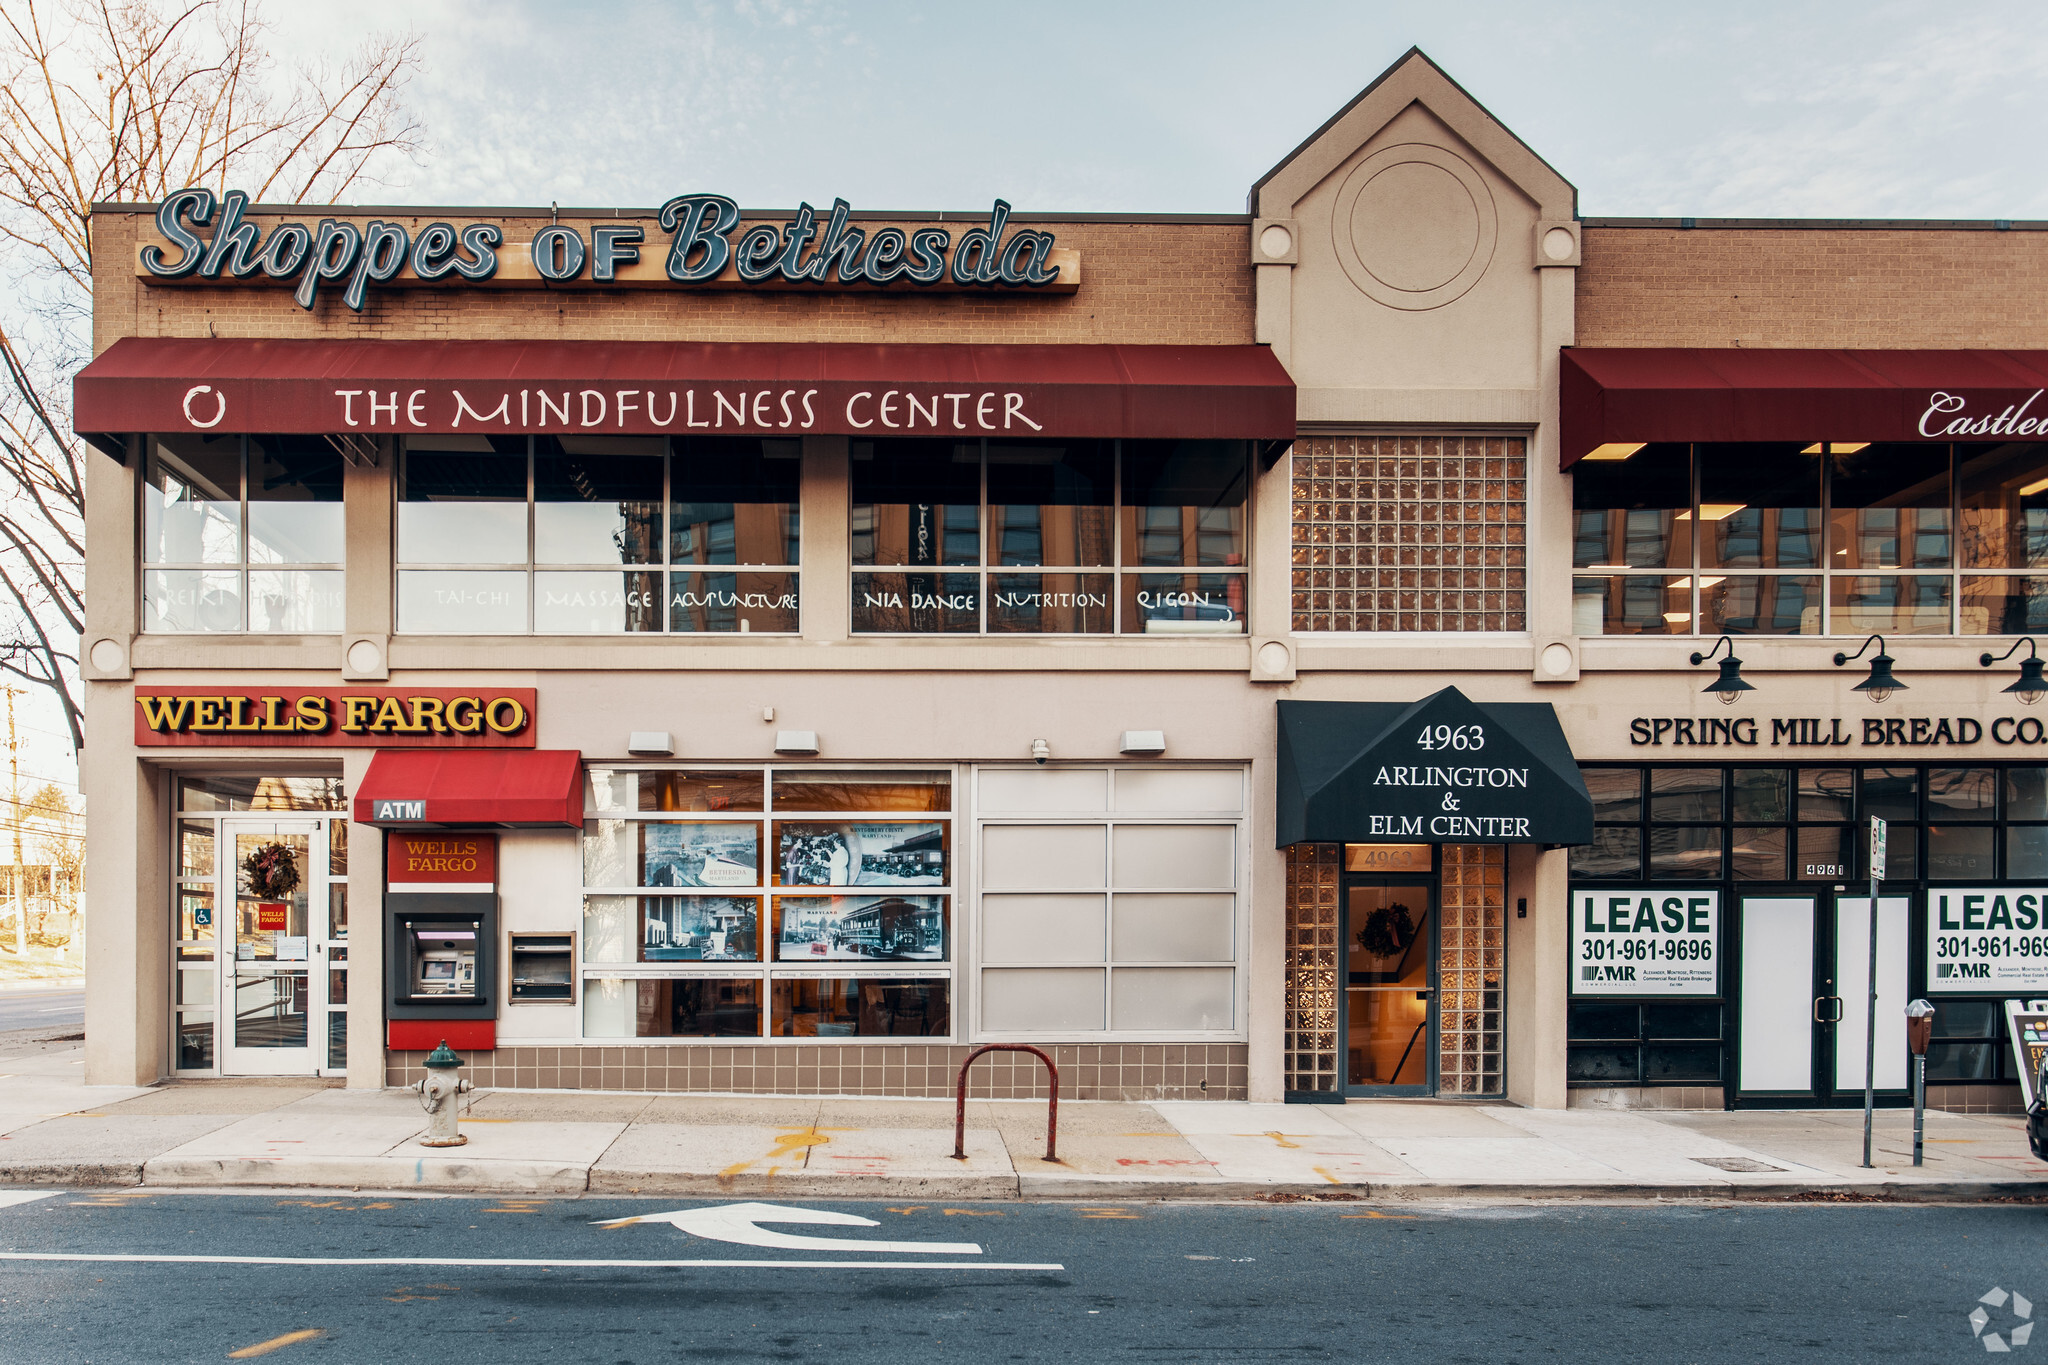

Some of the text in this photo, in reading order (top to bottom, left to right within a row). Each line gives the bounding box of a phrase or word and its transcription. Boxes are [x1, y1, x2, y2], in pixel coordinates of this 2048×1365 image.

[140, 188, 1060, 313] Shoppes OF Bethesda
[335, 388, 1043, 431] THE MINDFULNESS CENTER
[434, 589, 510, 607] TAI-CHI
[545, 590, 653, 608] MASSAGE
[863, 592, 975, 611] NIA DANCE
[994, 592, 1106, 609] NUTRITION
[136, 695, 528, 735] WELLS FARGO
[1416, 724, 1486, 751] 4963
[1630, 717, 2048, 745] SPRING MILL BREAD CO.
[1372, 765, 1529, 788] ARLINGTON
[378, 802, 422, 819] ATM
[1441, 791, 1461, 811] &
[1369, 815, 1531, 837] ELM CENTER
[405, 841, 478, 855] WELLS
[407, 857, 477, 872] FARGO
[1364, 850, 1413, 868] 4963
[1807, 864, 1844, 876] 4961
[1584, 897, 1710, 933] LEASE
[1581, 938, 1712, 960] 301-961-9696
[1592, 965, 1637, 981] AMR
[1946, 963, 1991, 979] AMR
